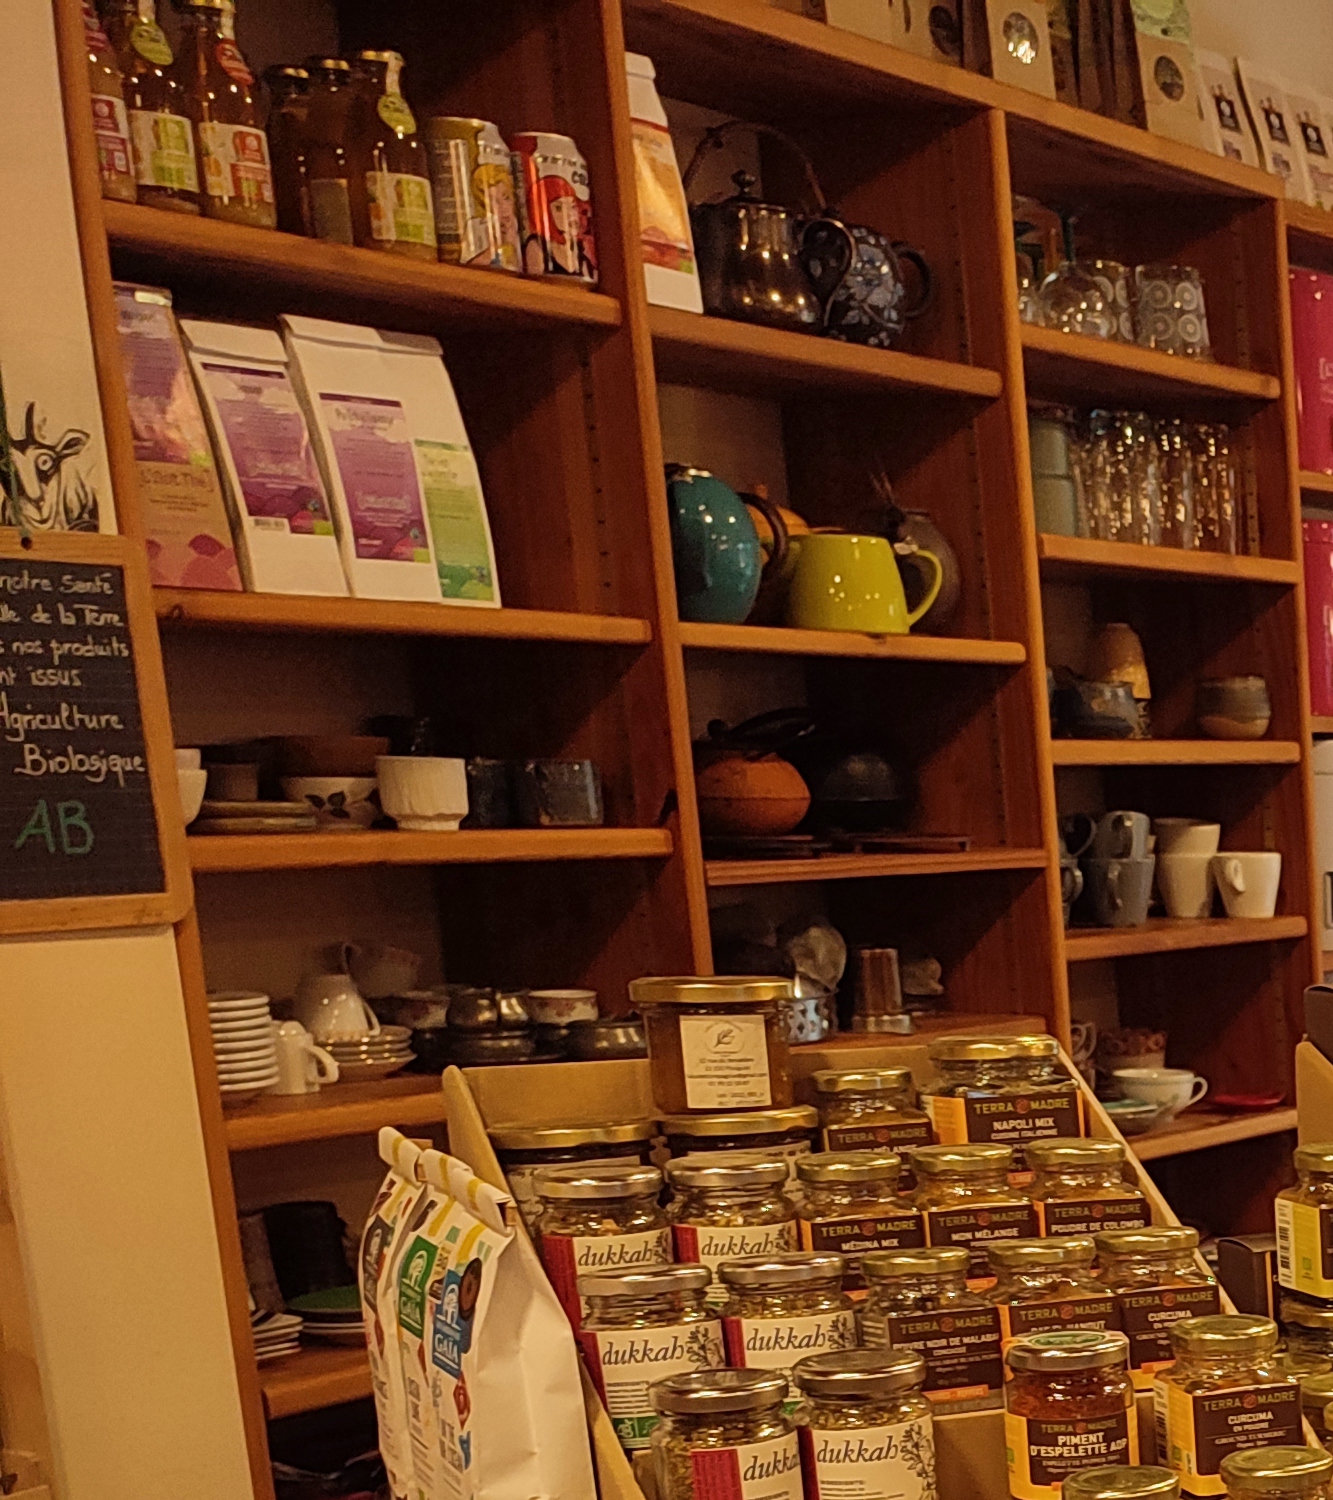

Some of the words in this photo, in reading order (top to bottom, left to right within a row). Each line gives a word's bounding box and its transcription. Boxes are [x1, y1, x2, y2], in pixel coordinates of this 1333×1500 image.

[50, 634, 129, 665] produits
[27, 666, 82, 686] issus
[14, 743, 146, 788] Biologique
[14, 799, 95, 854] AB
[993, 1119, 1032, 1131] NAPOLI
[1035, 1117, 1055, 1129] MIX
[579, 1241, 653, 1267] dukkah
[702, 1233, 775, 1257] dukkah
[1147, 1310, 1193, 1323] CURCUMA
[746, 1314, 827, 1351] dukkah
[603, 1336, 684, 1367] dukkah
[1203, 1397, 1241, 1411] TERRA
[1257, 1390, 1296, 1403] MADRE
[1227, 1411, 1274, 1425] CURCUMA
[817, 1435, 899, 1464] dukkah
[1030, 1442, 1108, 1457] D'ESPELETTE
[1057, 1432, 1104, 1446] PIMENT
